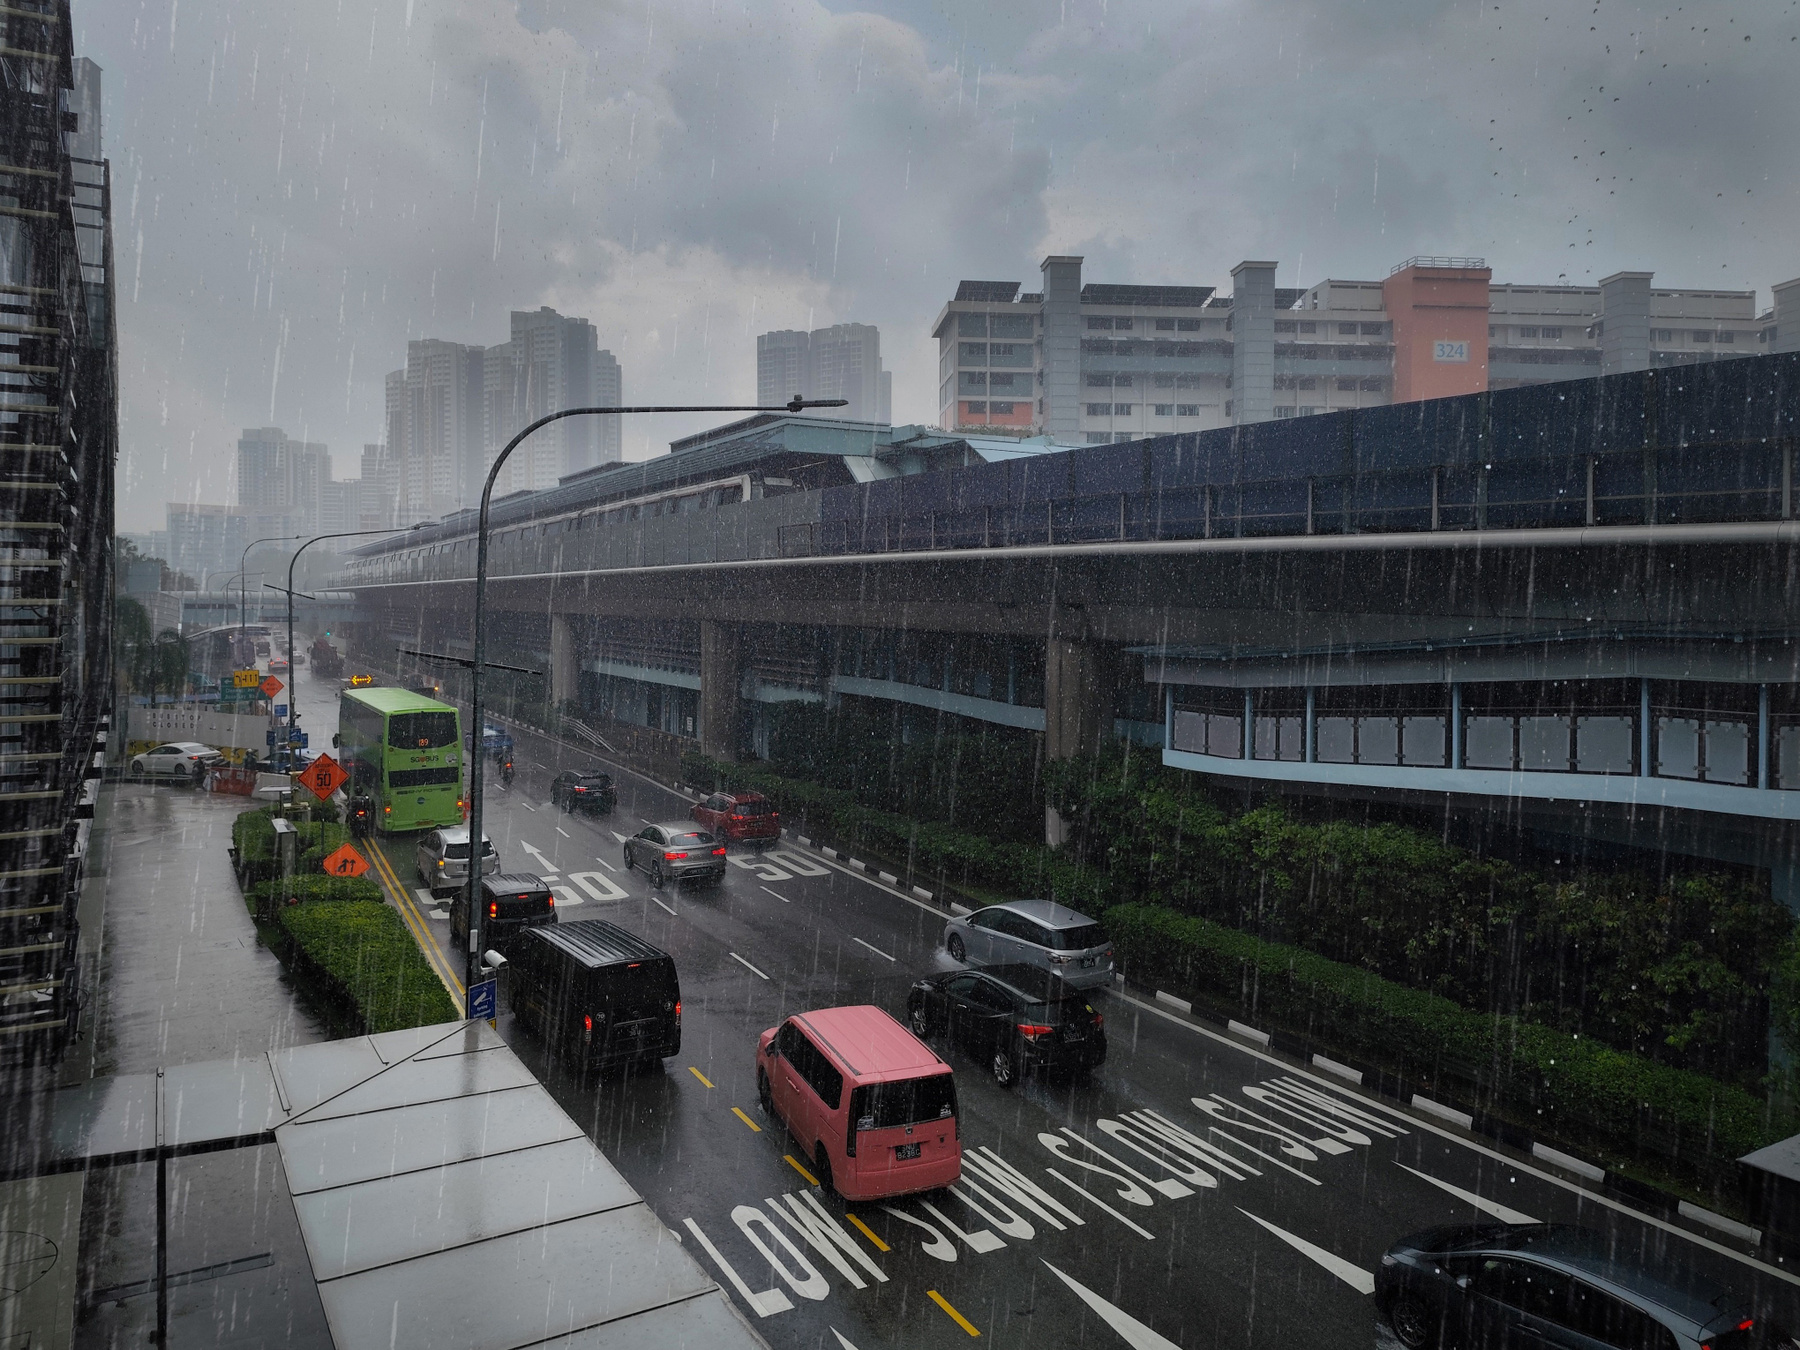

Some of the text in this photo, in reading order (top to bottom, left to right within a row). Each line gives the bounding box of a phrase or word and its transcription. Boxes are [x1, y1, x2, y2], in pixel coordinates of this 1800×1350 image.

[1436, 343, 1464, 358] 324
[418, 738, 429, 747] 189
[316, 773, 332, 787] 50
[726, 850, 831, 881] 50
[1191, 1076, 1411, 1161] SLOW
[1037, 1108, 1264, 1206] SLOW
[680, 1189, 890, 1318] LOW
